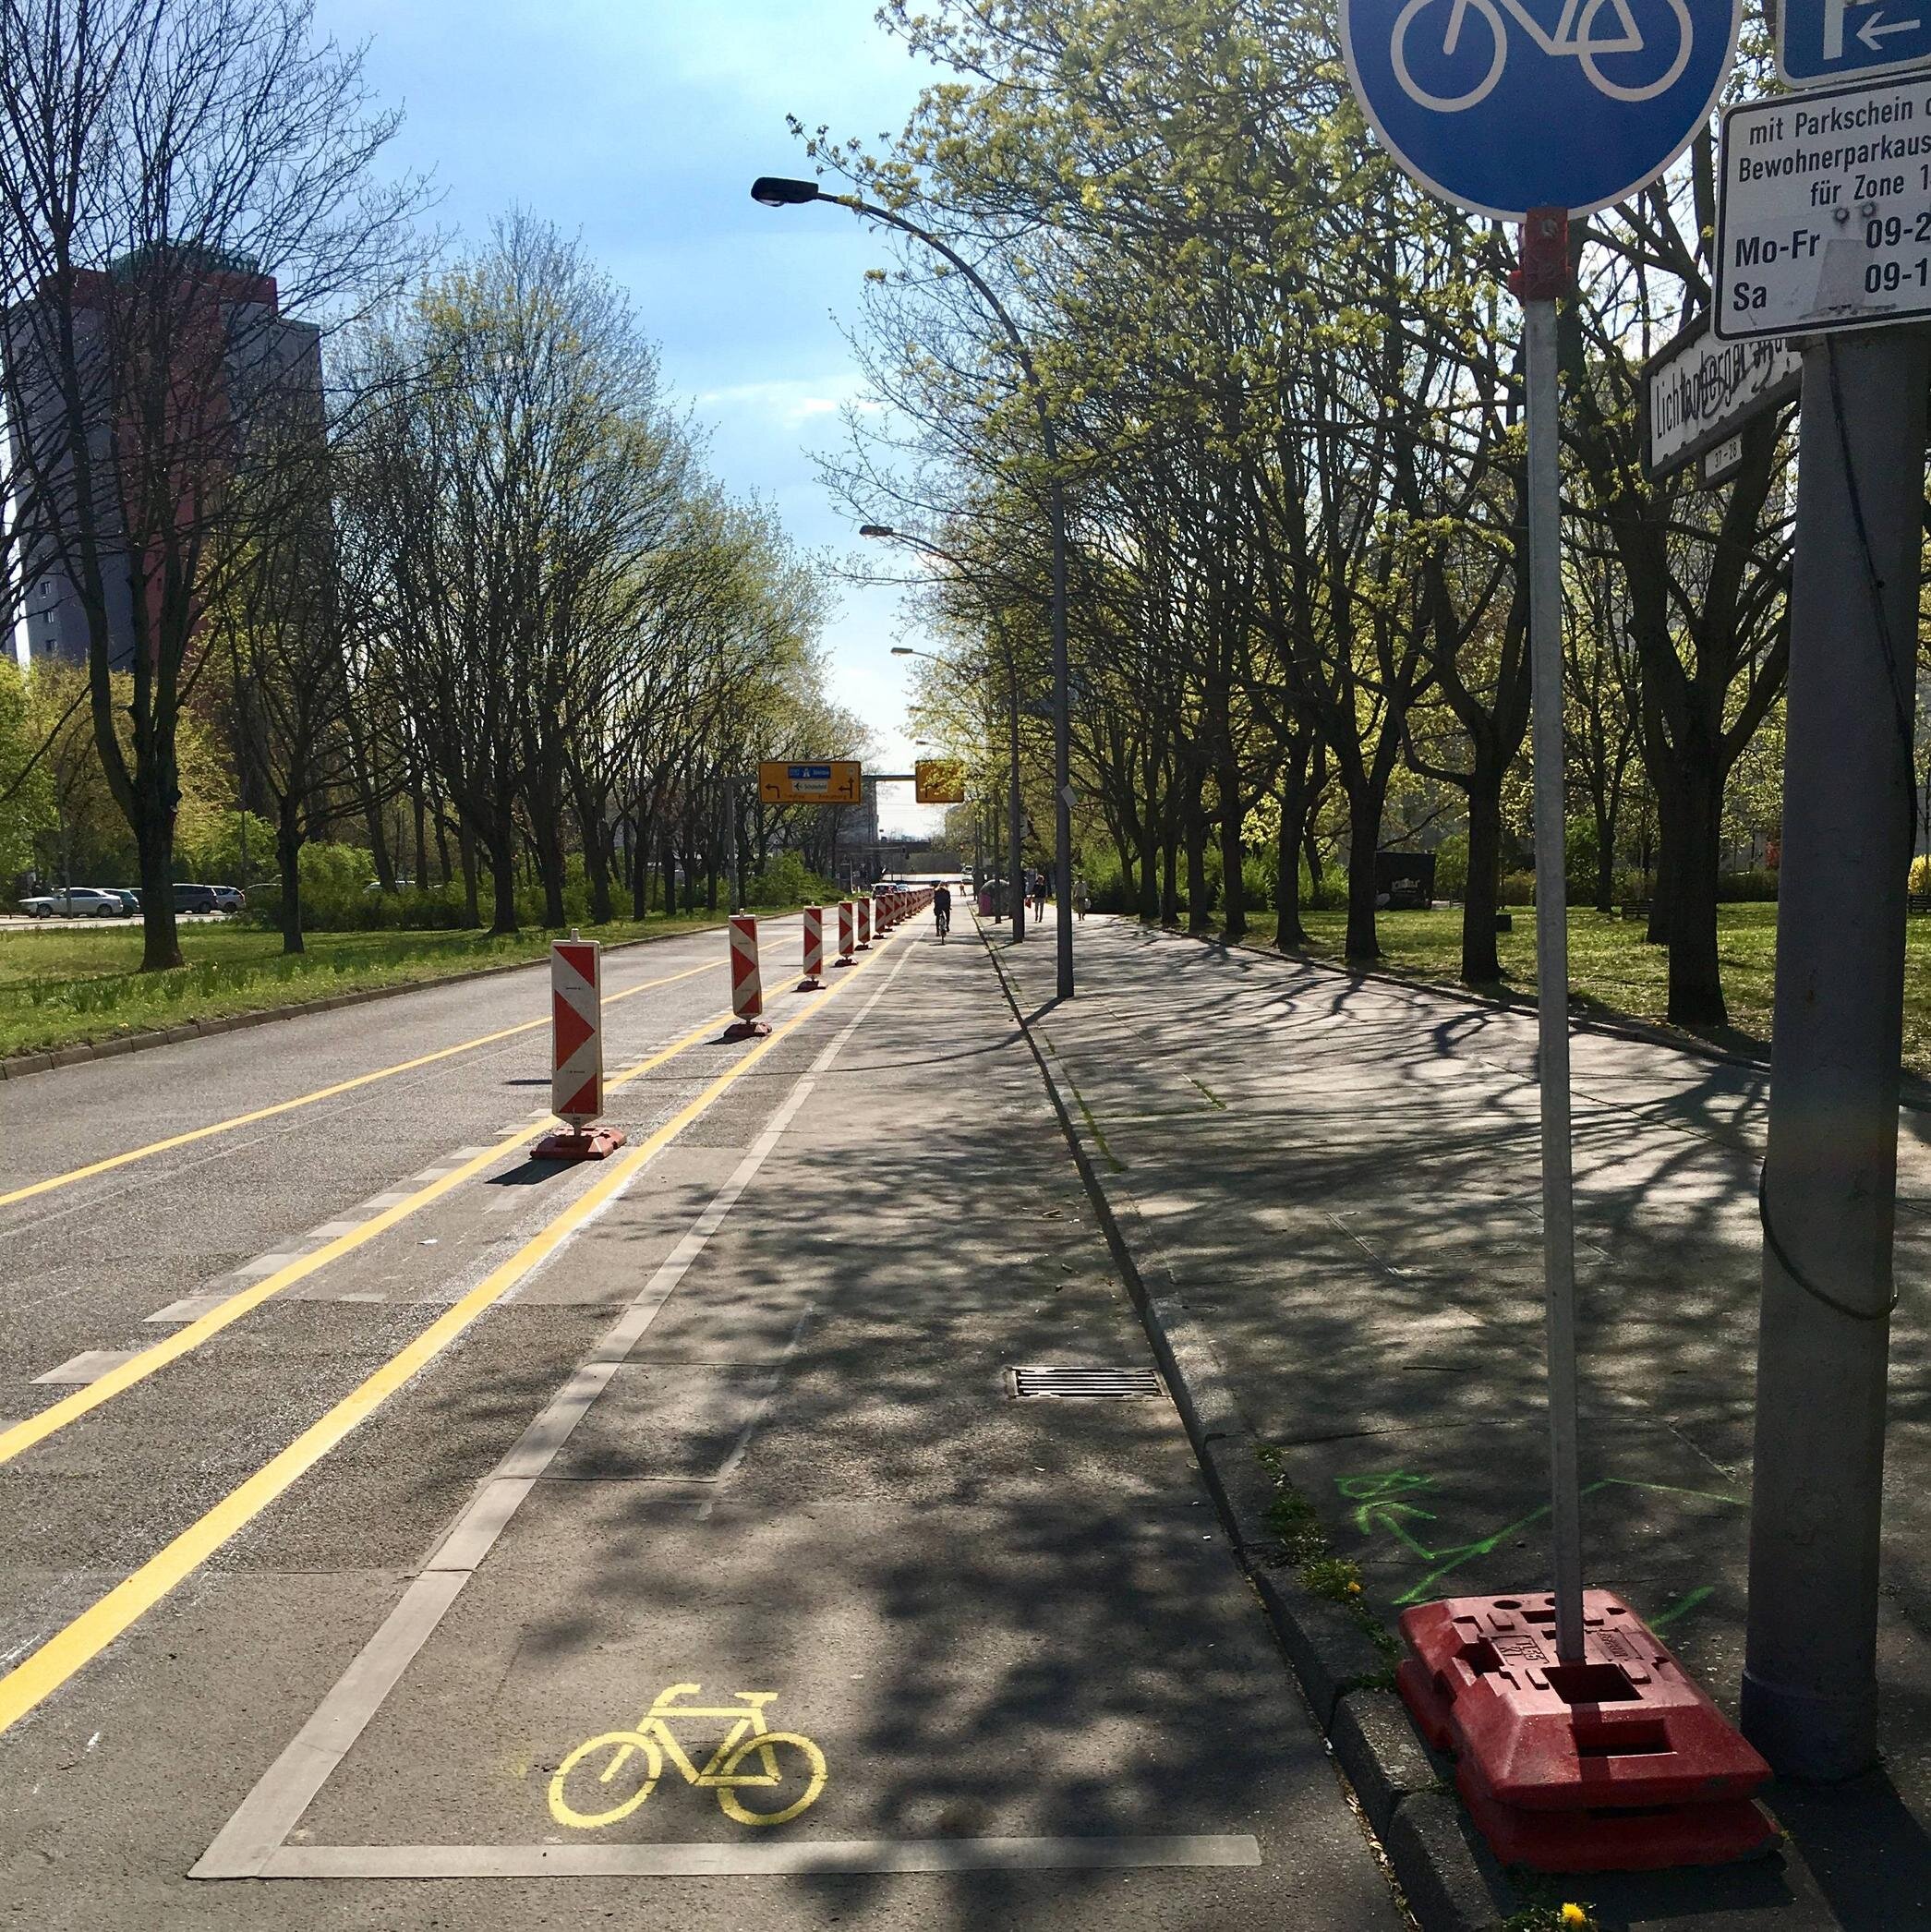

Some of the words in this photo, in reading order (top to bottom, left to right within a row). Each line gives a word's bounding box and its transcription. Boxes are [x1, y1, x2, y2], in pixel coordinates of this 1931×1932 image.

[1750, 117, 1783, 146] mit
[1796, 96, 1913, 139] Parkschein
[1739, 134, 1931, 183] Bewohnerparkaus
[1811, 181, 1842, 208] für
[1853, 174, 1905, 200] Zone
[1920, 163, 1931, 190] 1
[1735, 230, 1820, 268] Mo-Fr
[1865, 211, 1931, 249] 09-2
[1733, 282, 1768, 312] Sa
[1865, 258, 1928, 294] 09-1
